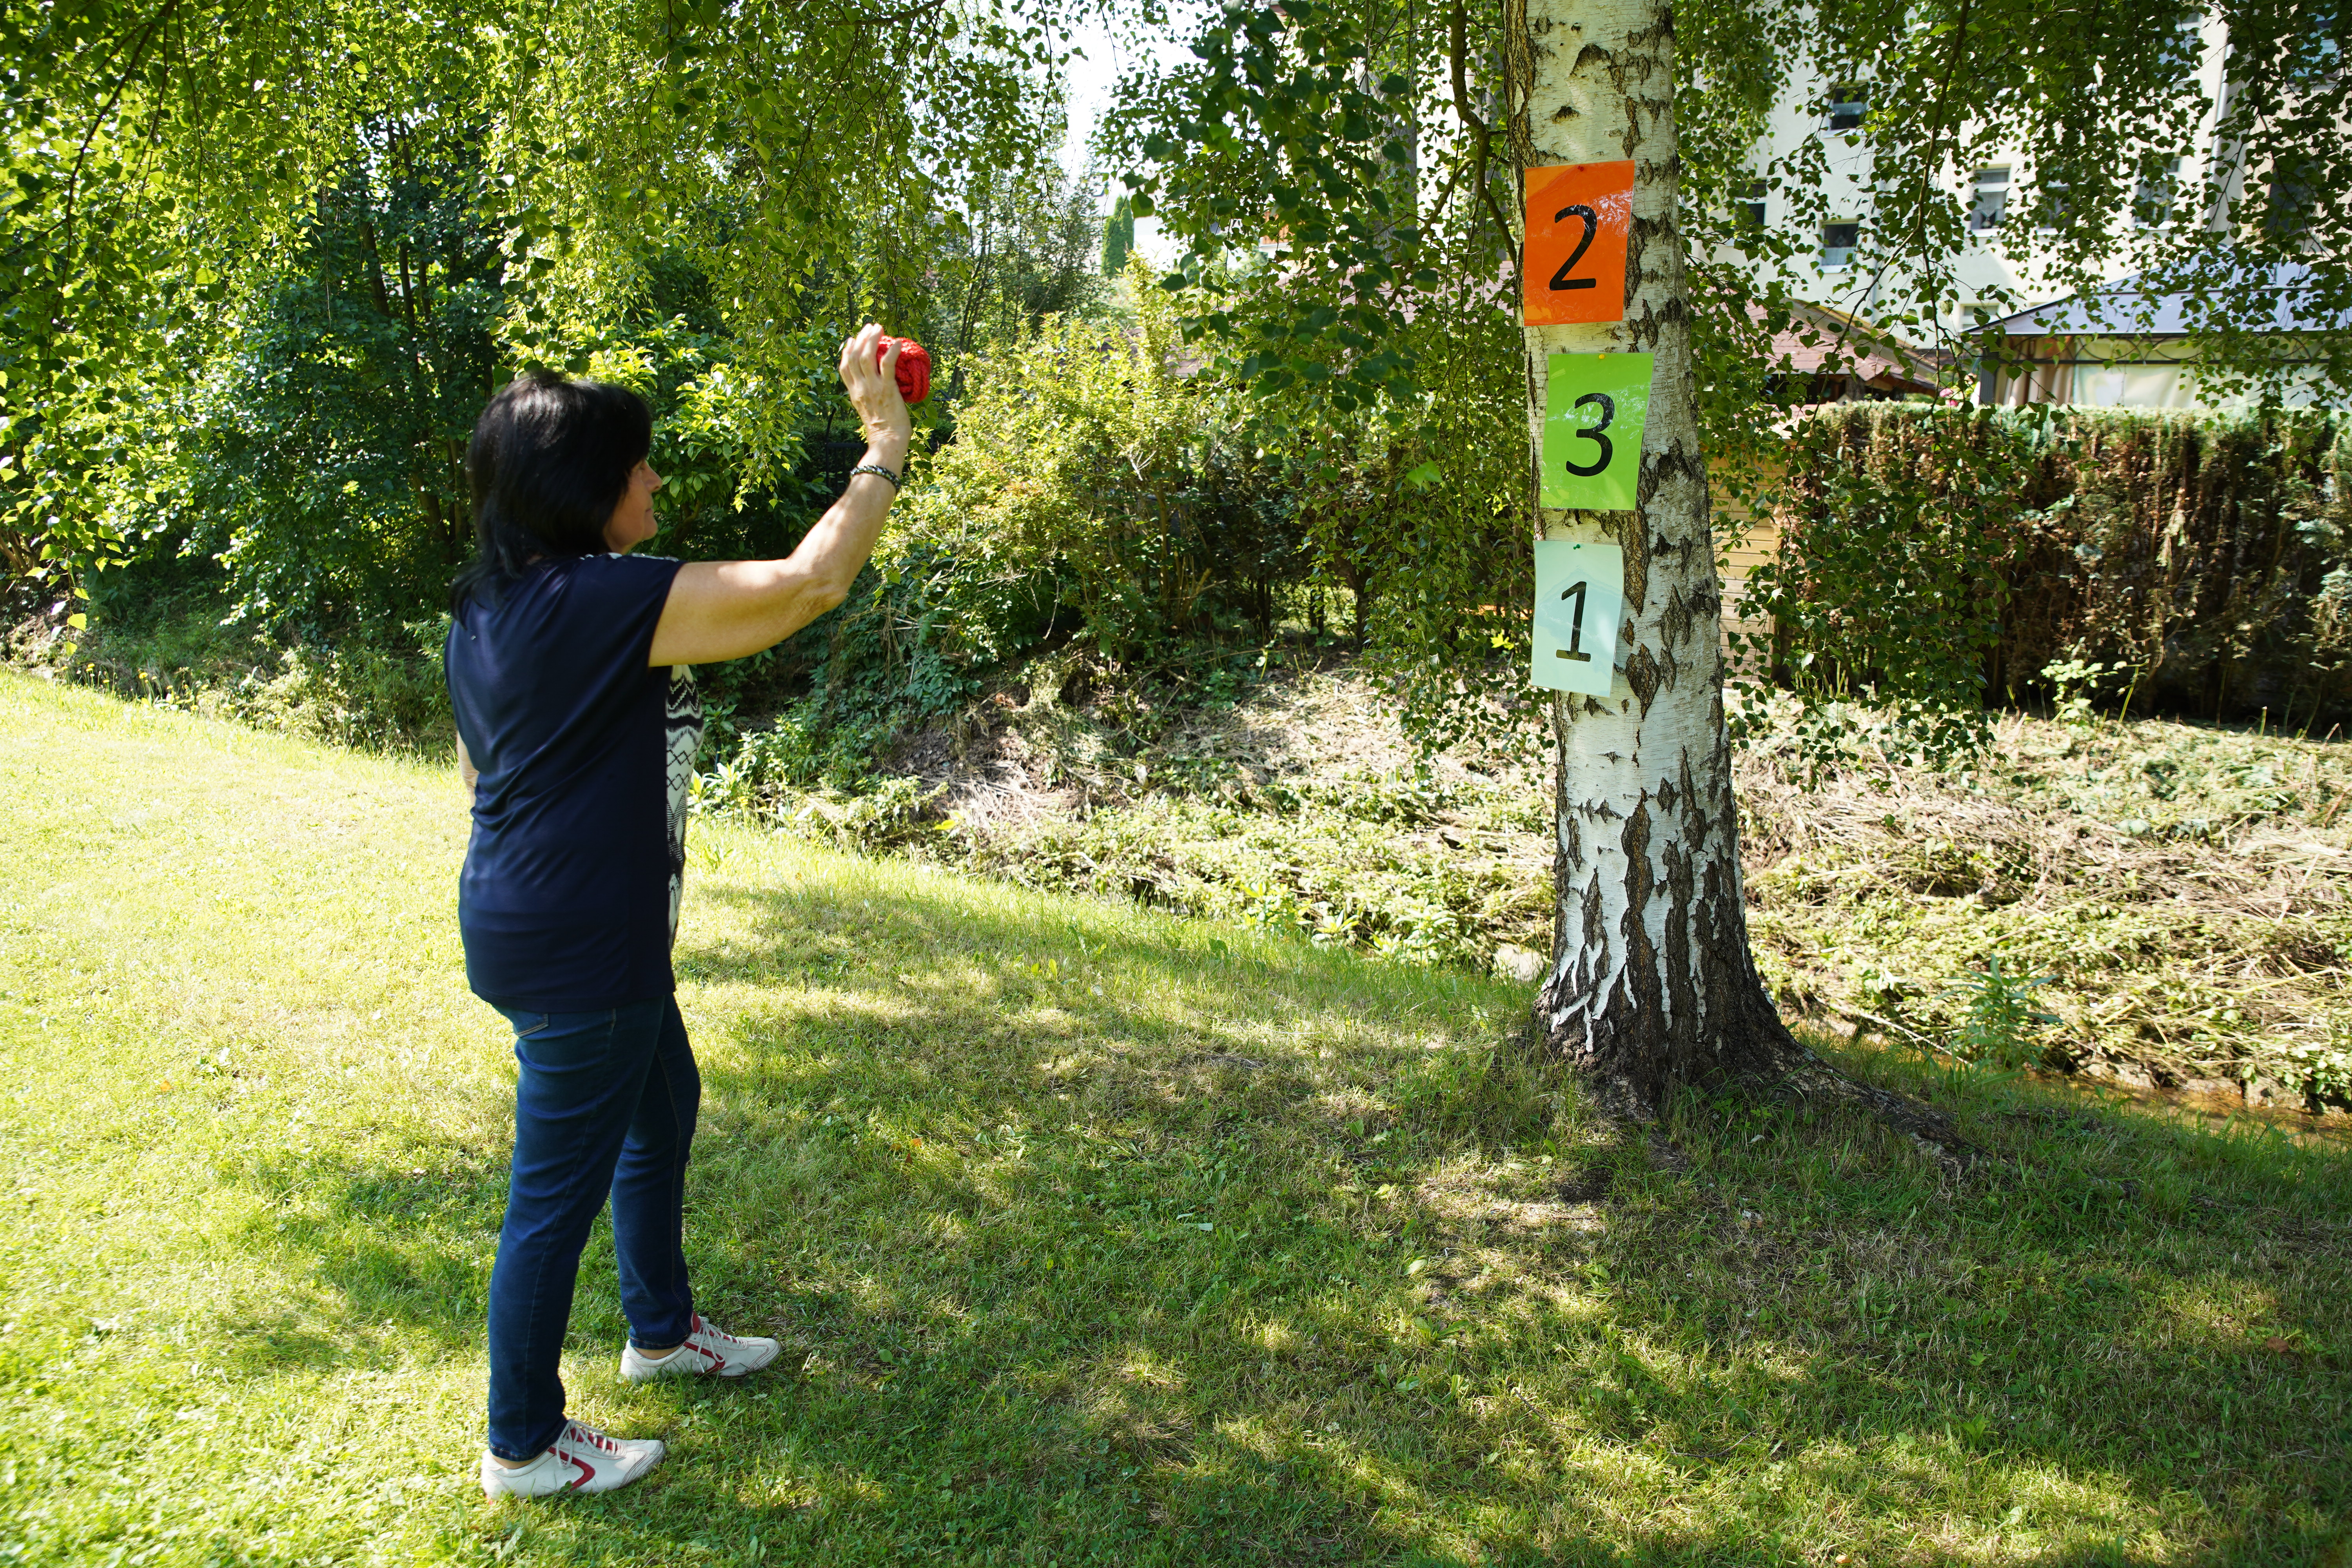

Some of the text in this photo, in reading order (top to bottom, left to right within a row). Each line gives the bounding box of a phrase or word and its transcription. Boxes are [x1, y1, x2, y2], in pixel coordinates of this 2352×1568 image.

[1549, 205, 1597, 291] 2
[1566, 393, 1615, 477] 3
[1556, 581, 1591, 662] 1
